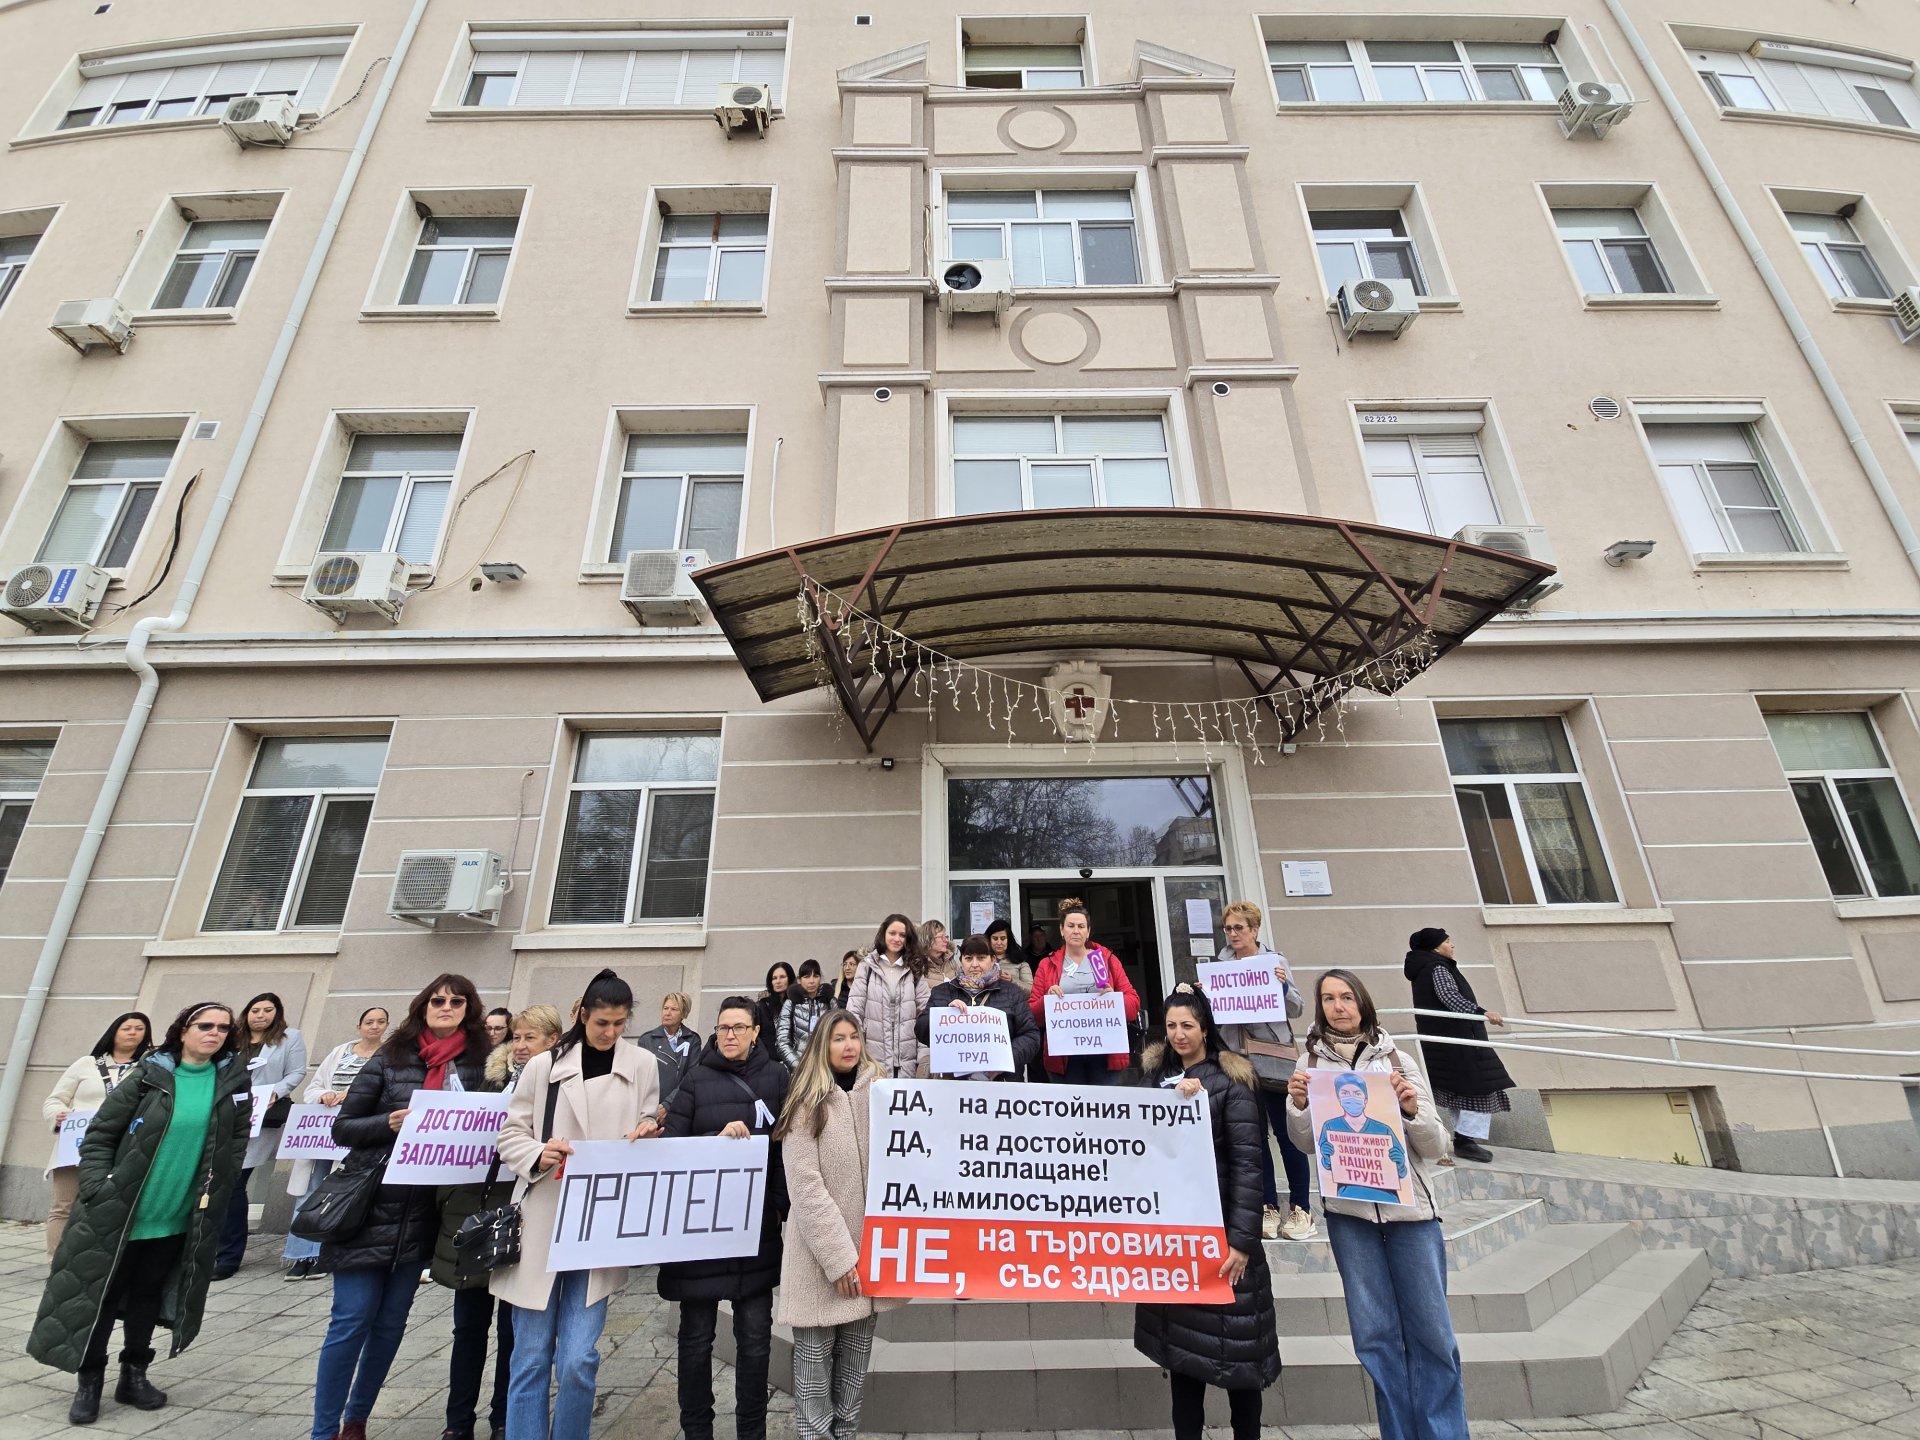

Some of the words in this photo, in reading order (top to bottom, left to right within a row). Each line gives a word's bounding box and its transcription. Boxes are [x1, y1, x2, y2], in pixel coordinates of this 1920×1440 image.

[1364, 415, 1375, 423] 62
[1376, 415, 1387, 423] 22
[1387, 415, 1398, 423] 22
[1210, 969, 1270, 991] ДОСТОЙНО
[1053, 997, 1115, 1013] ДОСТОЙНИ
[1208, 994, 1279, 1012] АПЛАЩАНЕ
[939, 1011, 1001, 1027] ДОСТОЙНИ
[1051, 1018, 1102, 1029] УСЛОВИЯ
[1106, 1017, 1121, 1027] НА
[935, 1033, 991, 1044] УСЛОВИЯ
[994, 1033, 1008, 1045] НА
[1074, 1036, 1103, 1047] ТРУД
[958, 1052, 989, 1065] ТРУД
[889, 1089, 933, 1117] ДА,
[959, 1097, 987, 1115] на
[995, 1096, 1130, 1119] достойния
[1139, 1100, 1202, 1126] труд!
[297, 1115, 338, 1130] ДОСТО
[886, 1130, 932, 1158] ДА,
[960, 1133, 989, 1151] на
[996, 1131, 1145, 1156] достойното
[1329, 1133, 1360, 1144] ВАШИЯТ
[1362, 1136, 1390, 1147] ЖИВОТ
[396, 1143, 507, 1169] ЗАПЛАЩАН
[1338, 1144, 1372, 1157] ЗАВИСИ
[1374, 1148, 1384, 1158] ОТ
[1338, 1156, 1383, 1170] НАШИЯ
[958, 1159, 1108, 1184] заплащане!
[1346, 1169, 1384, 1186] ТРУД!
[554, 1167, 763, 1243] ПРОТЕСТ
[882, 1182, 928, 1212] ДА,
[958, 1191, 1160, 1218] милосърдието!
[869, 1227, 966, 1295] НЕ,
[979, 1228, 1015, 1252] на
[1025, 1228, 1221, 1261] търговията
[999, 1263, 1061, 1288] със
[1072, 1261, 1199, 1296] здраве!
